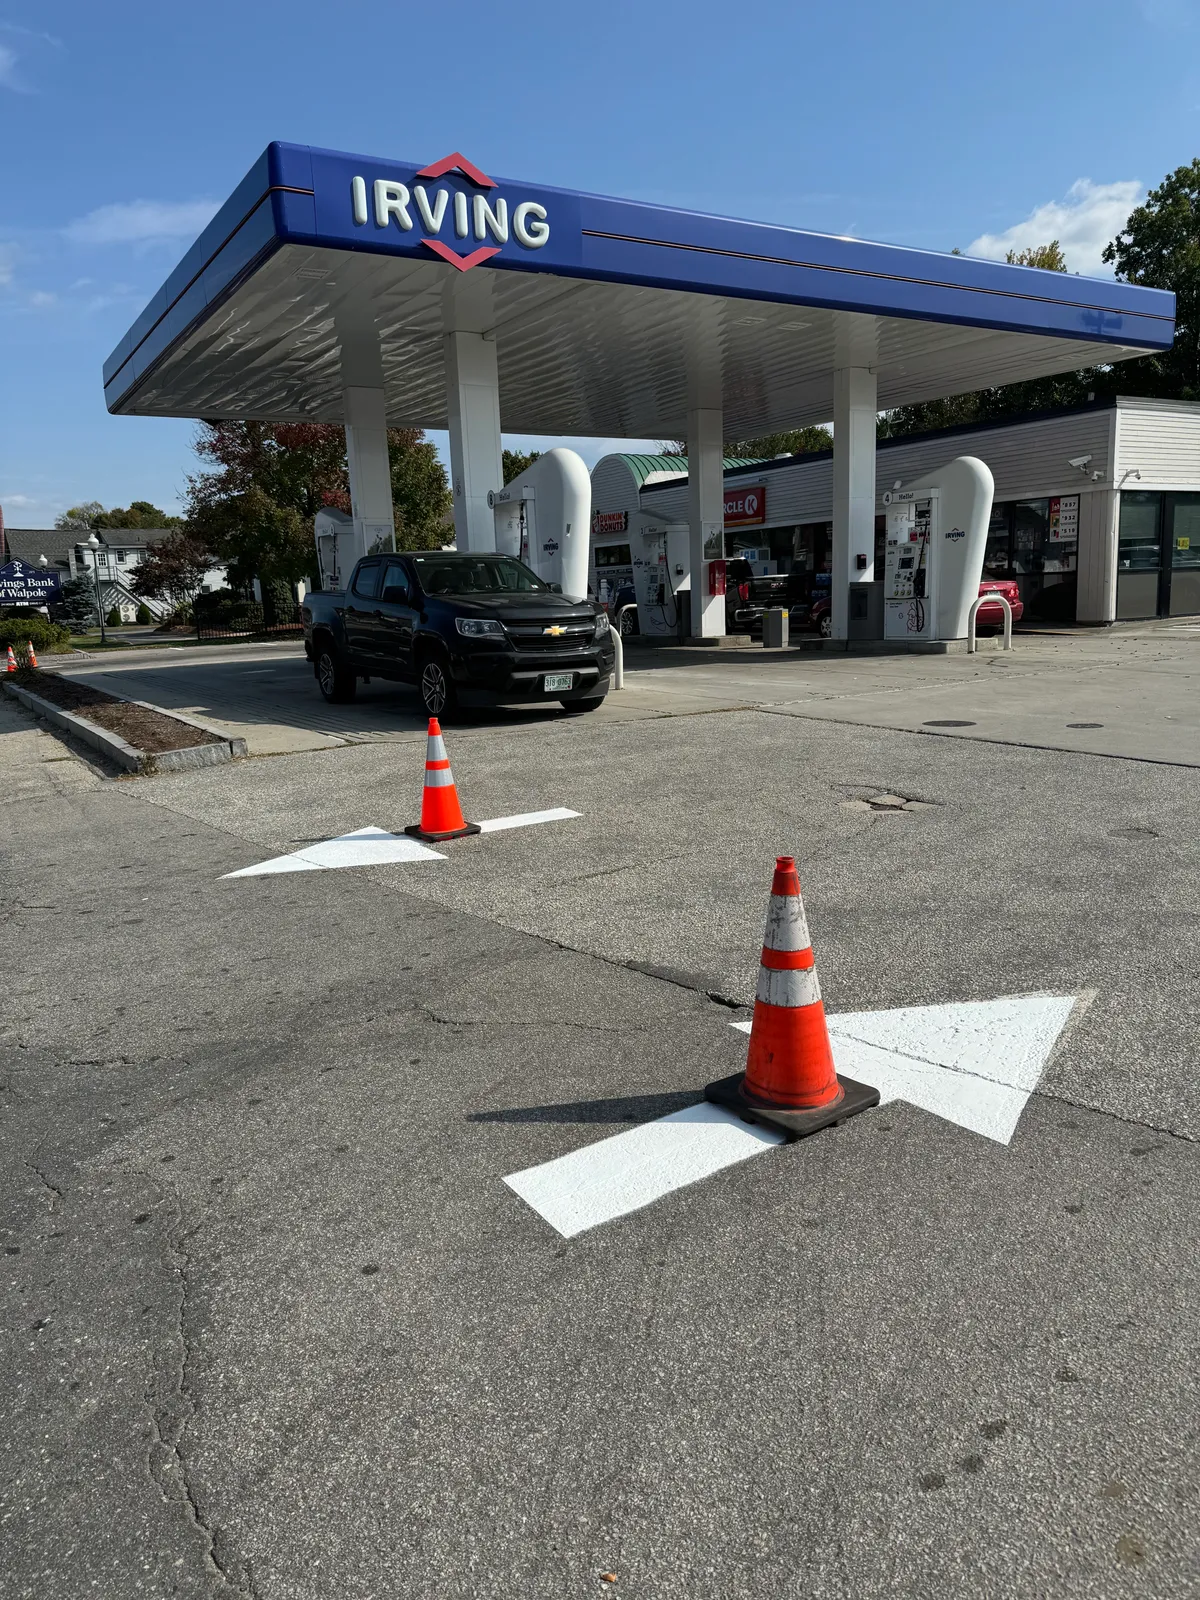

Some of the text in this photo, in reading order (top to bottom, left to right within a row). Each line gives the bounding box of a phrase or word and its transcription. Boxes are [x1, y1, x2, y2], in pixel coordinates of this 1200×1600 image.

[352, 176, 550, 249] IRVING
[885, 494, 890, 503] 4
[898, 493, 914, 501] Hello!
[600, 511, 624, 523] DUNKIN'
[600, 521, 624, 532] DONUTS
[945, 531, 965, 539] IRVING
[543, 542, 559, 551] IRVING
[27, 578, 55, 587] Bank
[7, 588, 47, 599] Walpole
